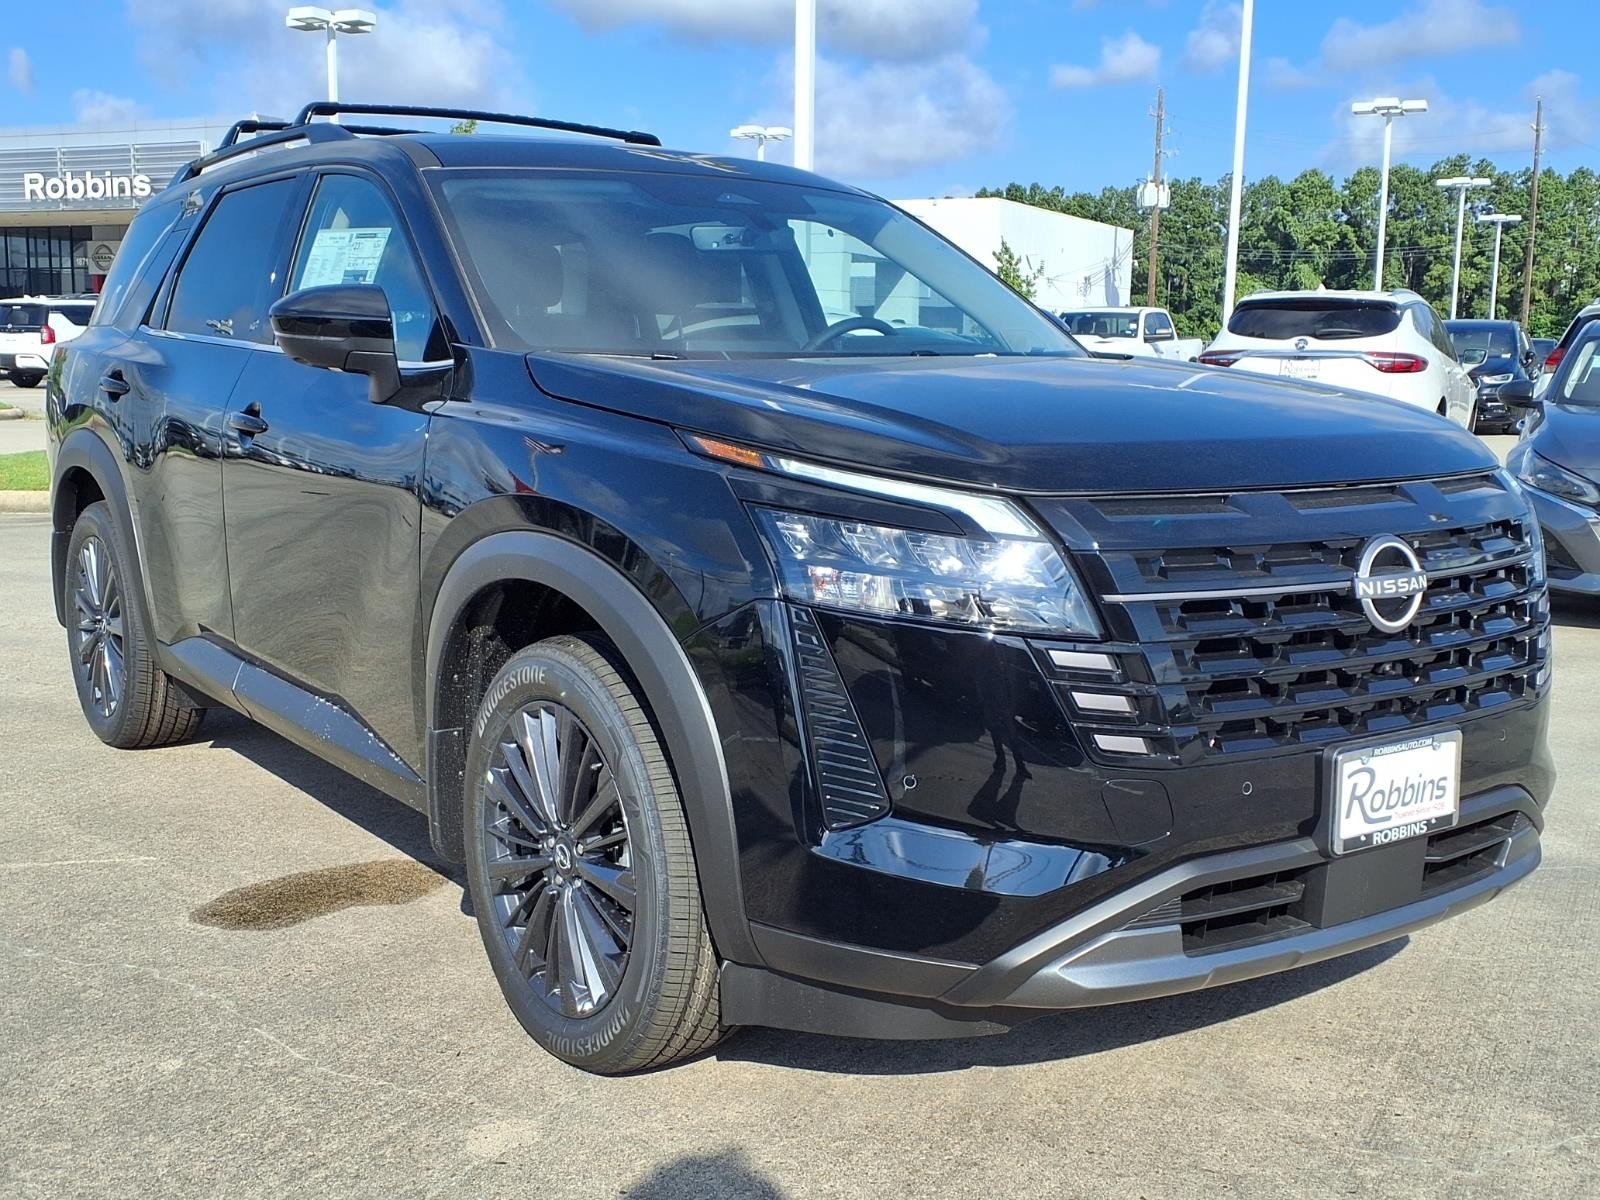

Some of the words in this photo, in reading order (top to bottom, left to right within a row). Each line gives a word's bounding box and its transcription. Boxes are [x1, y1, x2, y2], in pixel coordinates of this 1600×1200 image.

[24, 171, 151, 200] Robbins
[1358, 574, 1427, 596] NISSAN
[476, 665, 548, 738] BRIDGESTONE
[1344, 766, 1448, 825] Robbins
[1372, 820, 1428, 845] ROBBINS
